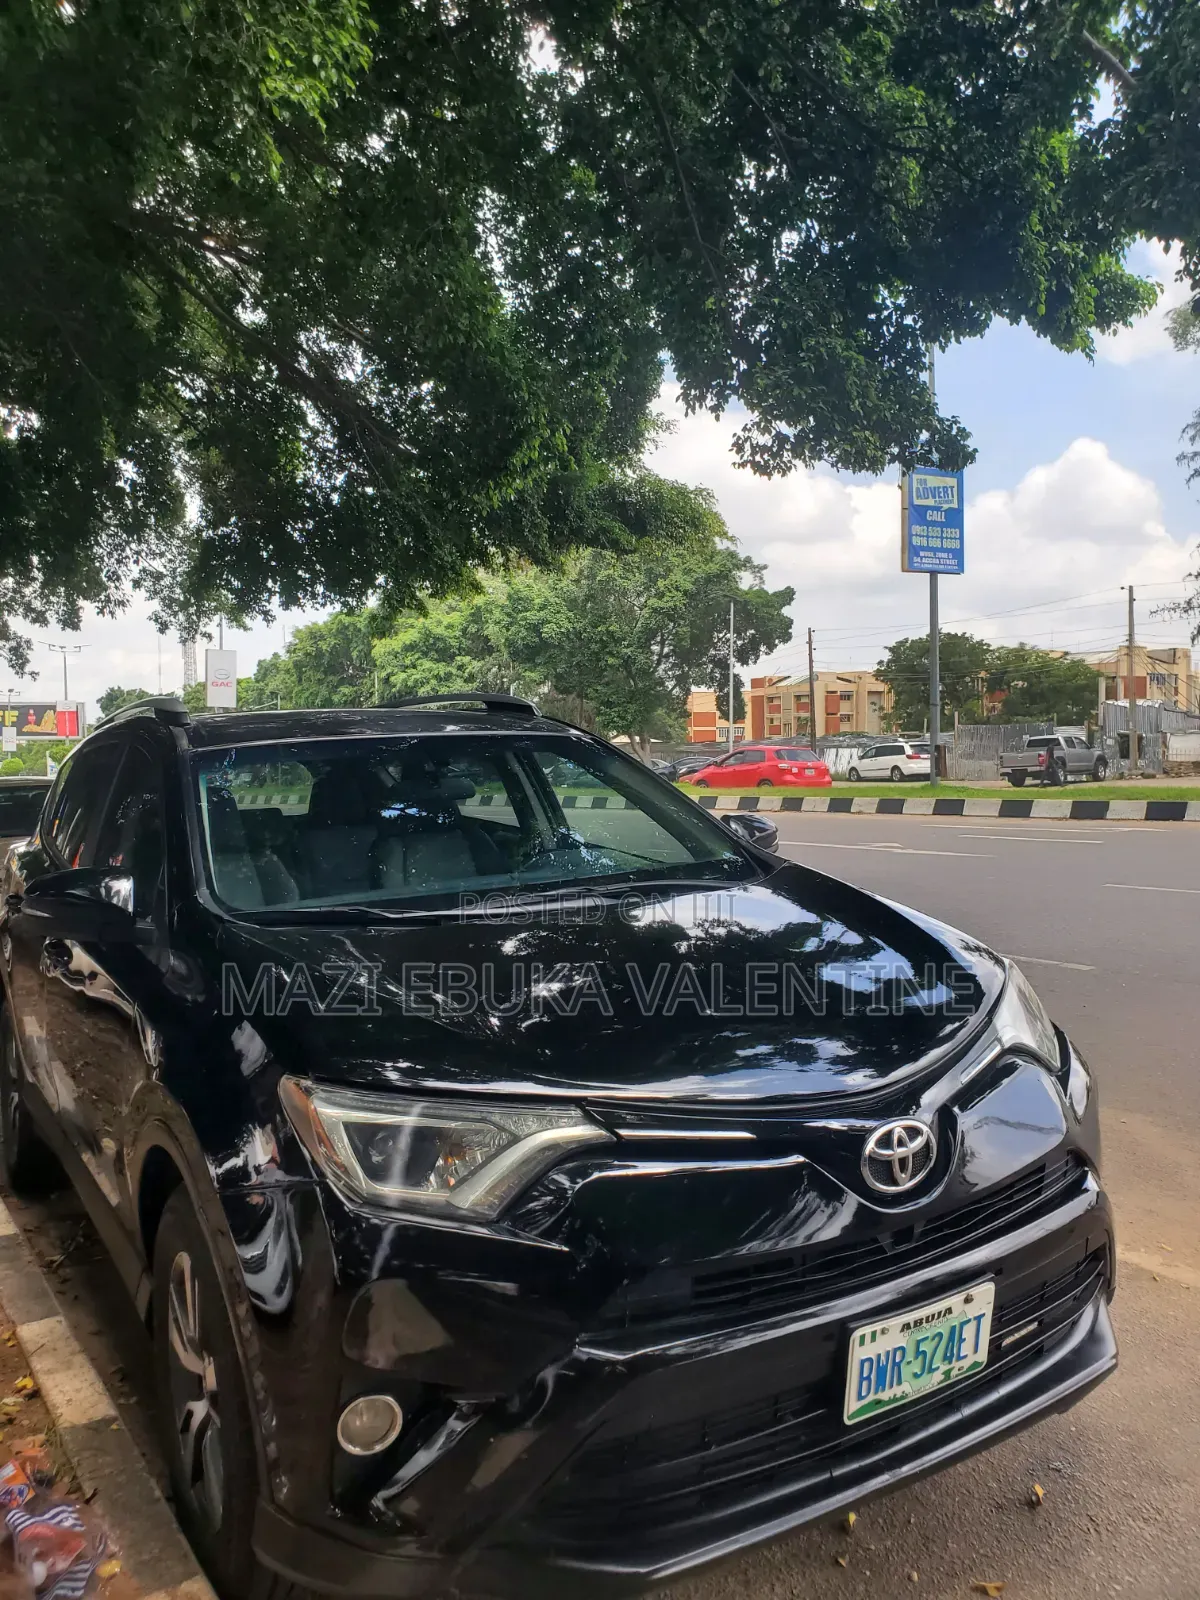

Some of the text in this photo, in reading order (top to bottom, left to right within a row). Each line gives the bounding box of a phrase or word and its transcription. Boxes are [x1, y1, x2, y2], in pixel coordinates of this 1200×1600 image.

[916, 478, 927, 487] FOR
[916, 486, 954, 500] ADVERT
[926, 510, 945, 521] CALL
[943, 528, 960, 539] 3333
[912, 535, 927, 547] 0916
[900, 1307, 953, 1333] ABUJA
[857, 1312, 986, 1401] BWR-524ET
